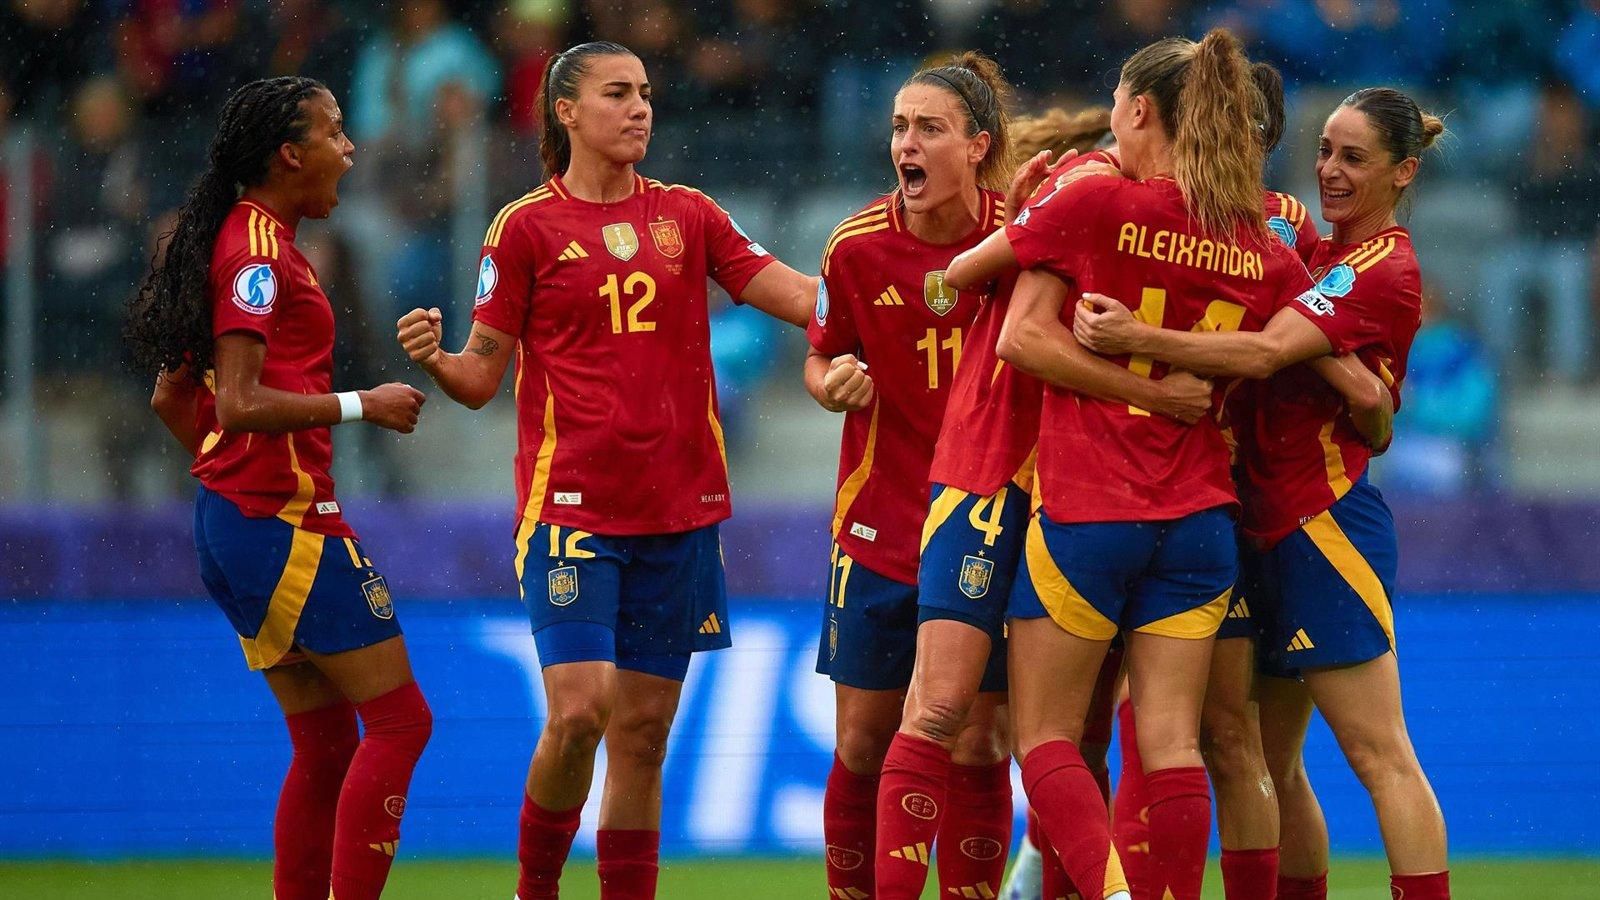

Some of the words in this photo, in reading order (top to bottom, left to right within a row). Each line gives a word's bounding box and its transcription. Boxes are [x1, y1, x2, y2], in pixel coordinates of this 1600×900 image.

[1118, 222, 1264, 281] ALEIXANDRI
[599, 271, 657, 334] 12
[917, 328, 962, 389] 11
[969, 487, 1003, 546] 4
[830, 542, 853, 608] 11
